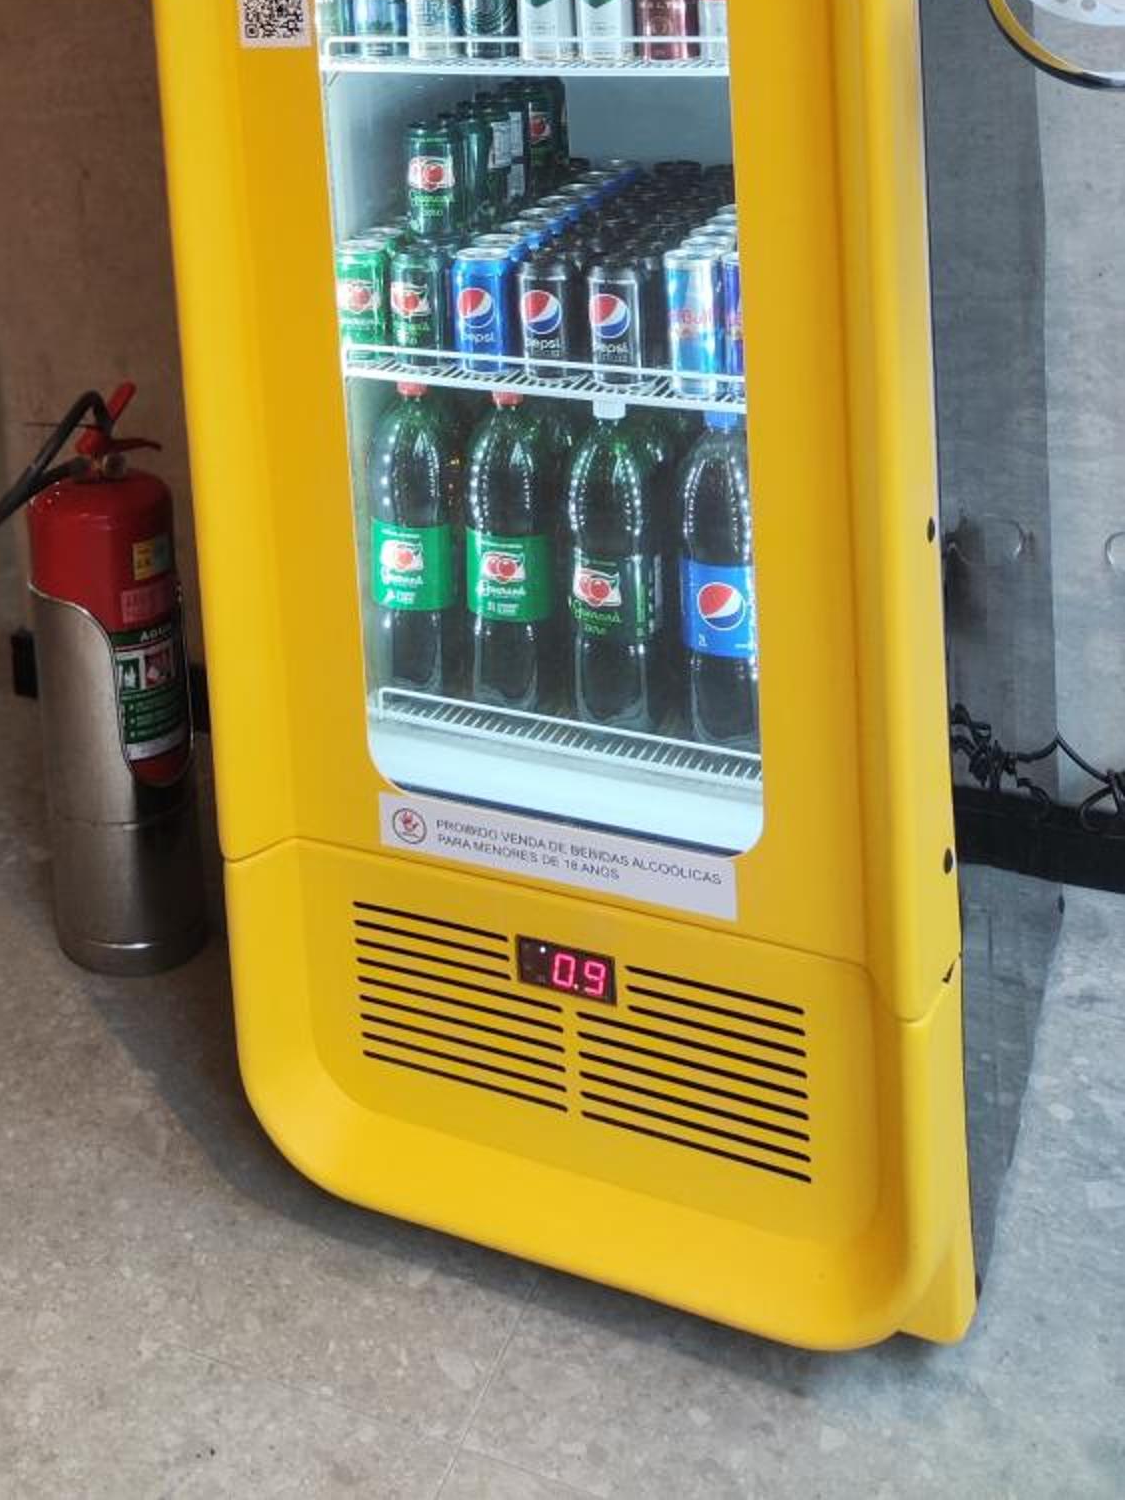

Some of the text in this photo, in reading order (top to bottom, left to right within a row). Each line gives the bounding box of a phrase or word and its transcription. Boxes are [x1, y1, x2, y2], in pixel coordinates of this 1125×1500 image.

[436, 819, 498, 840] PROIBIDO
[500, 831, 547, 851] VENDA
[548, 841, 568, 855] DE
[570, 844, 630, 867] BEBIDAS
[437, 833, 620, 880] PARA MENORES DE 18 ANOS
[551, 952, 606, 997] 0.9
